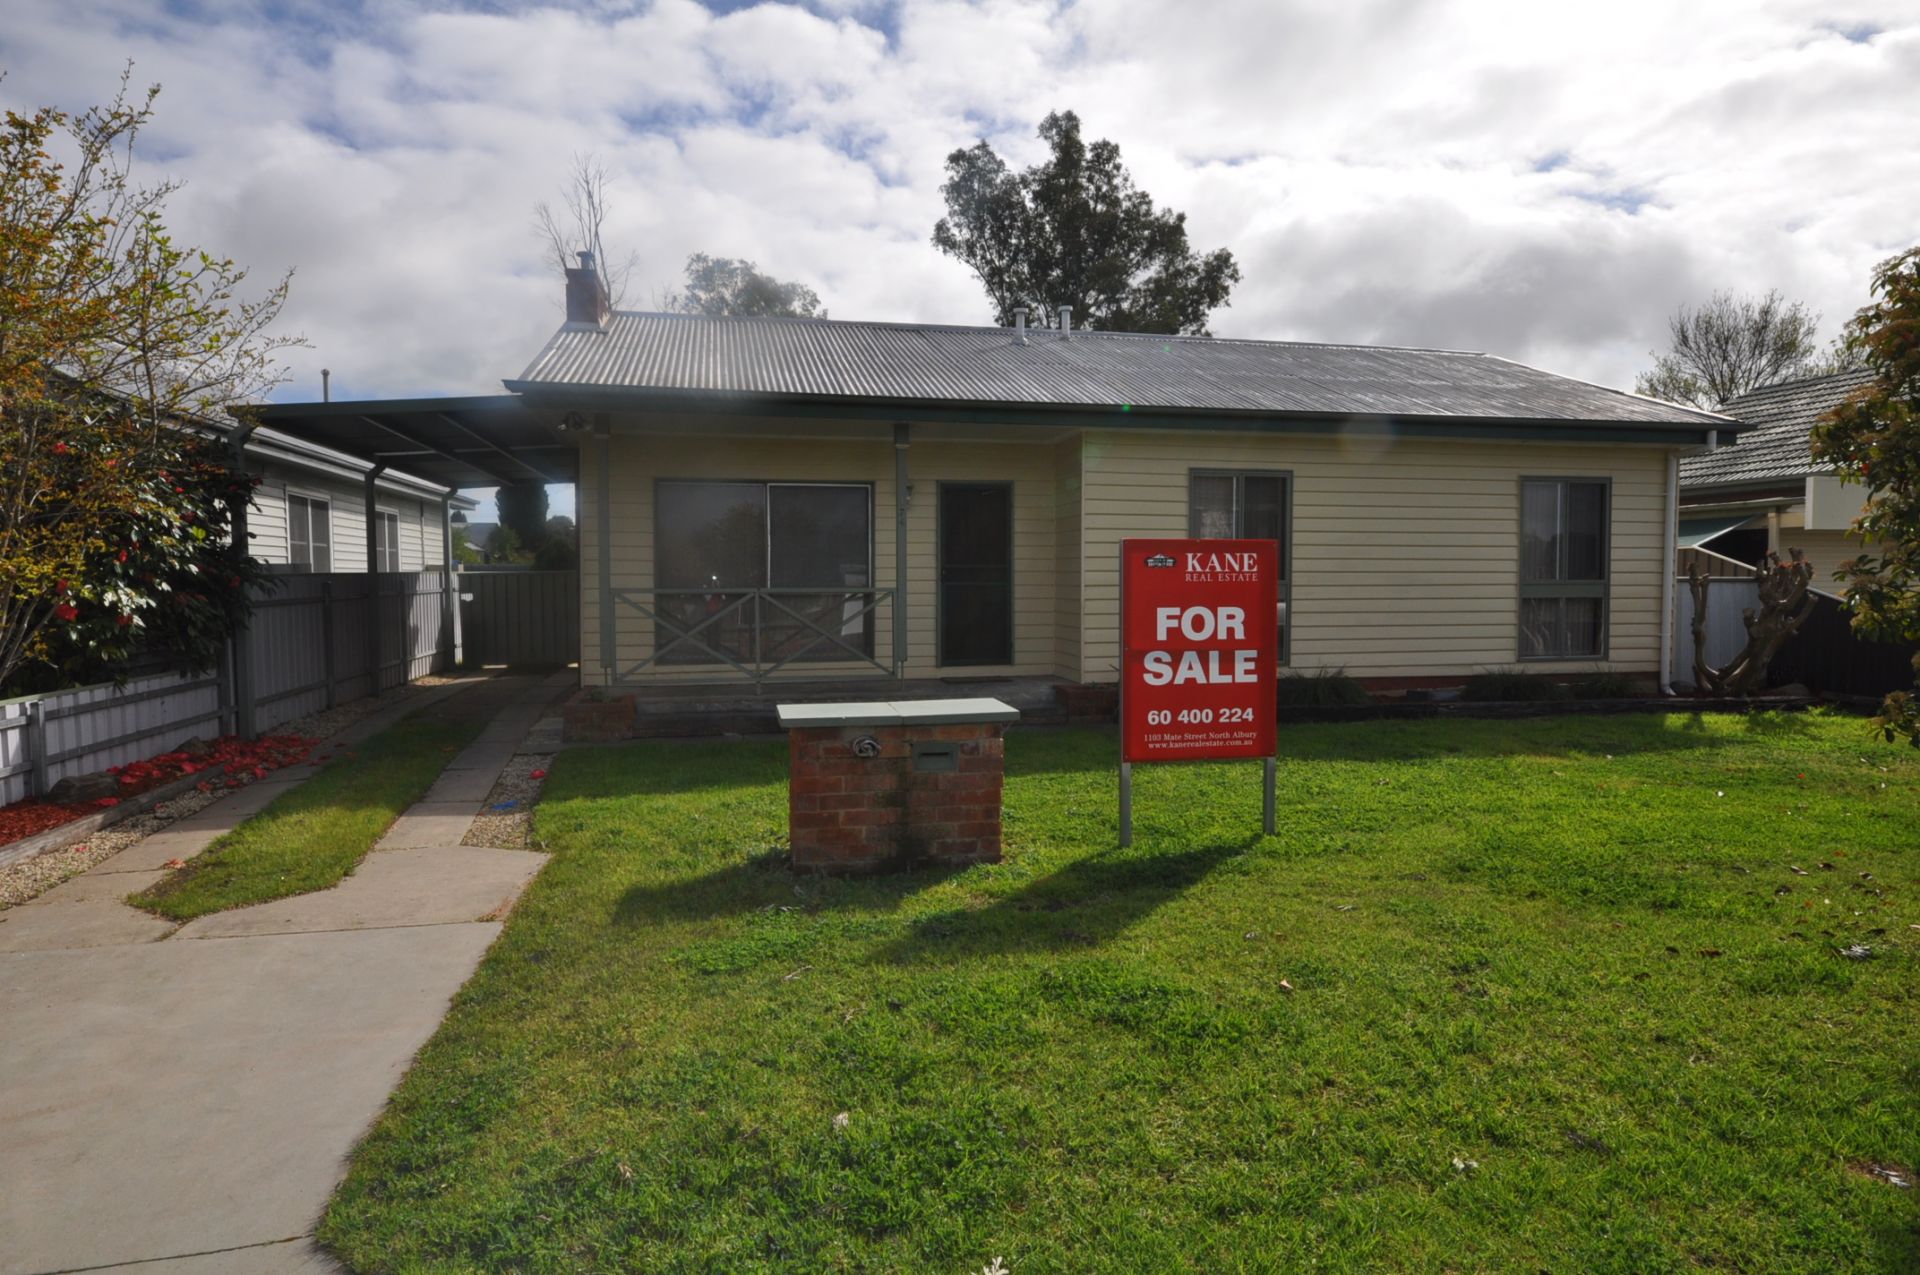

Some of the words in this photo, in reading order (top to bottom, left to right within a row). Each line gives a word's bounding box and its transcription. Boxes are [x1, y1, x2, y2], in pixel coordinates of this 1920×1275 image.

[1185, 552, 1258, 572] KANE
[1185, 573, 1213, 582] REAL
[1218, 573, 1258, 582] ESTATE
[1156, 606, 1246, 641] FOR
[1143, 649, 1258, 686] SALE
[1147, 710, 1172, 725] 60
[1177, 709, 1213, 724] 400
[1219, 708, 1254, 723] 224
[1163, 732, 1182, 740] Mate
[1184, 731, 1206, 739] Street
[1209, 731, 1230, 739] North
[1232, 730, 1257, 739] Albury
